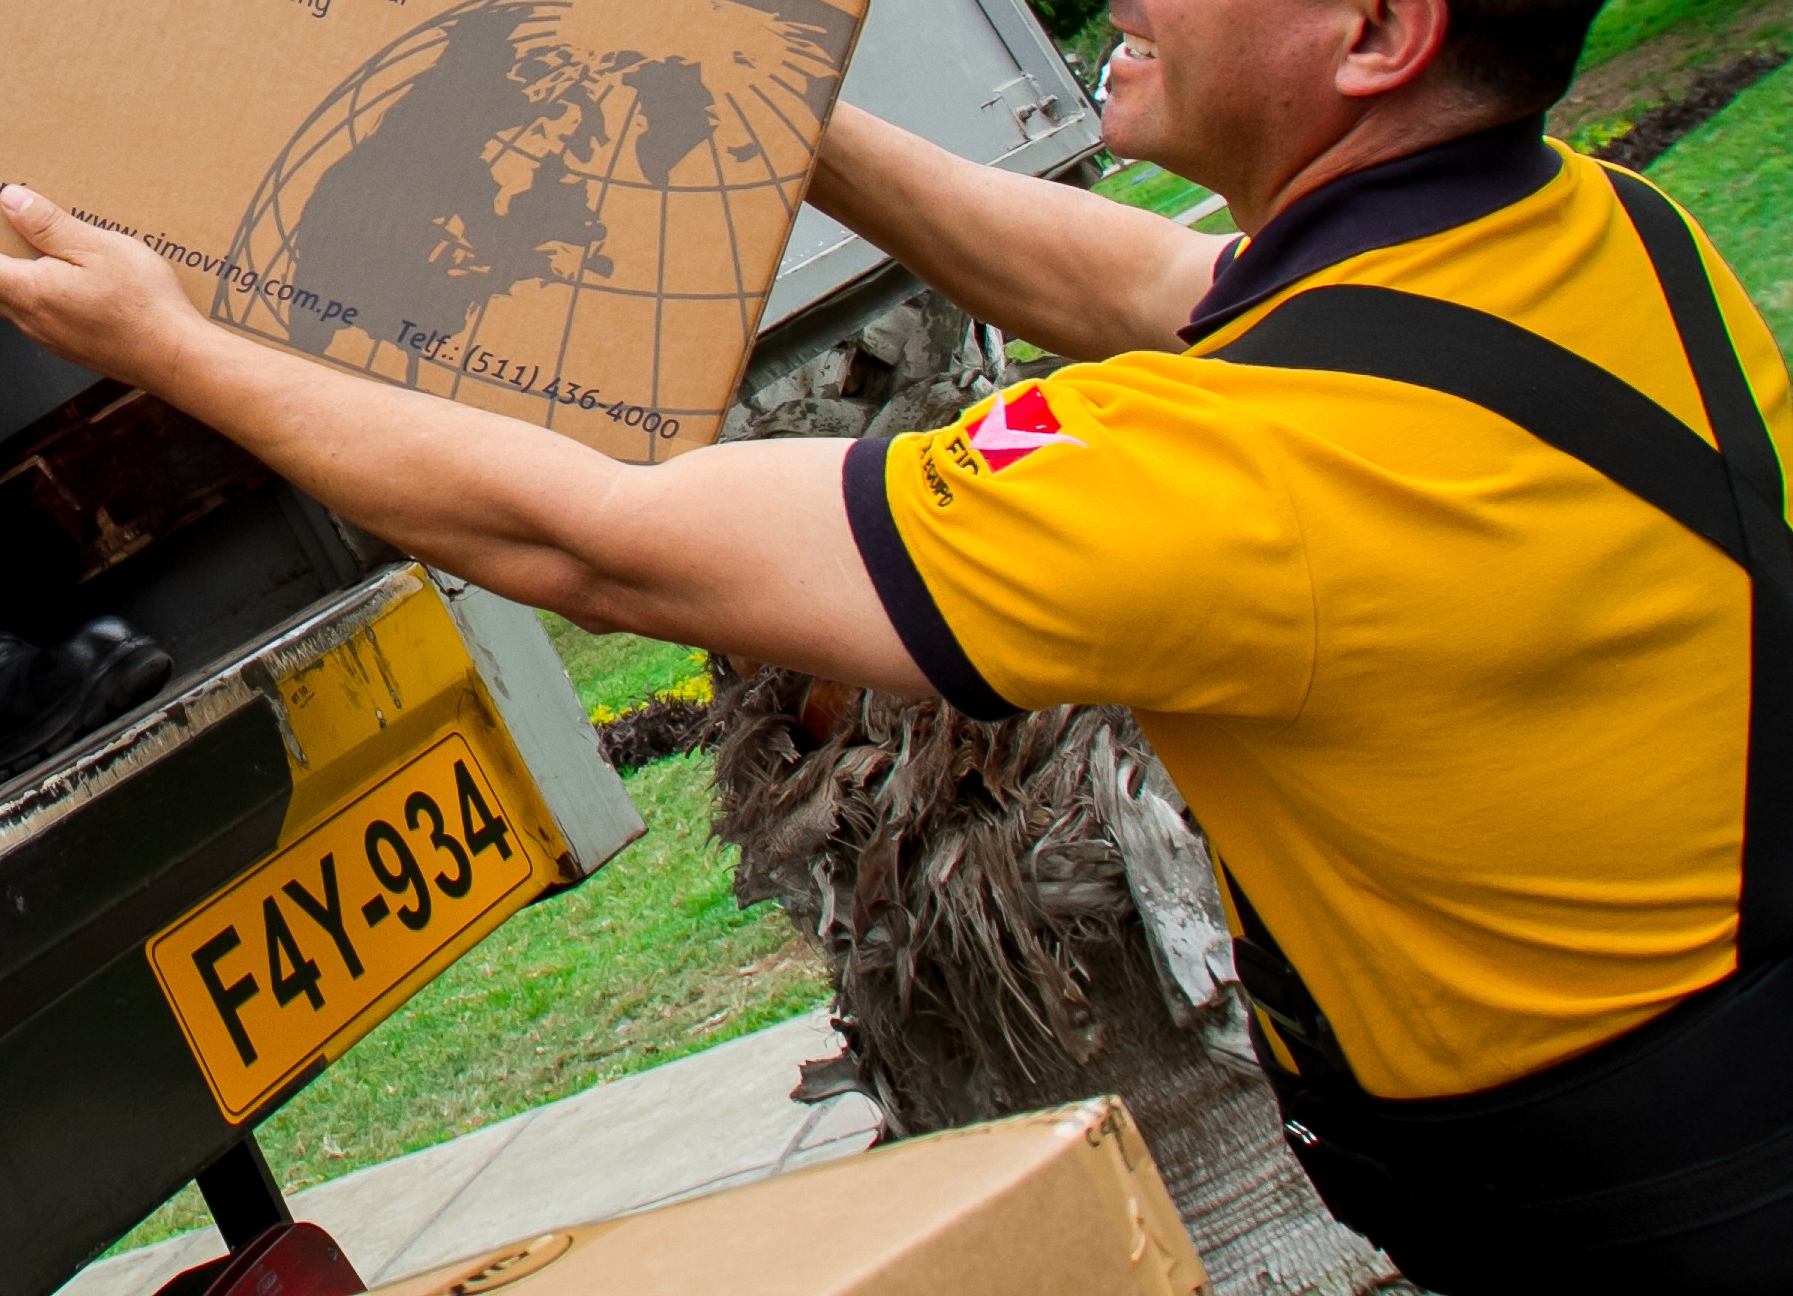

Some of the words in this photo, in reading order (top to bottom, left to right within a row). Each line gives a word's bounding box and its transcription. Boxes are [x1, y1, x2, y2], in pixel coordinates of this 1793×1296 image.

[397, 320, 459, 361] Telf.:
[463, 344, 539, 392] (511)
[542, 377, 680, 439] 436-4000
[191, 759, 514, 1068] F4Y-934
